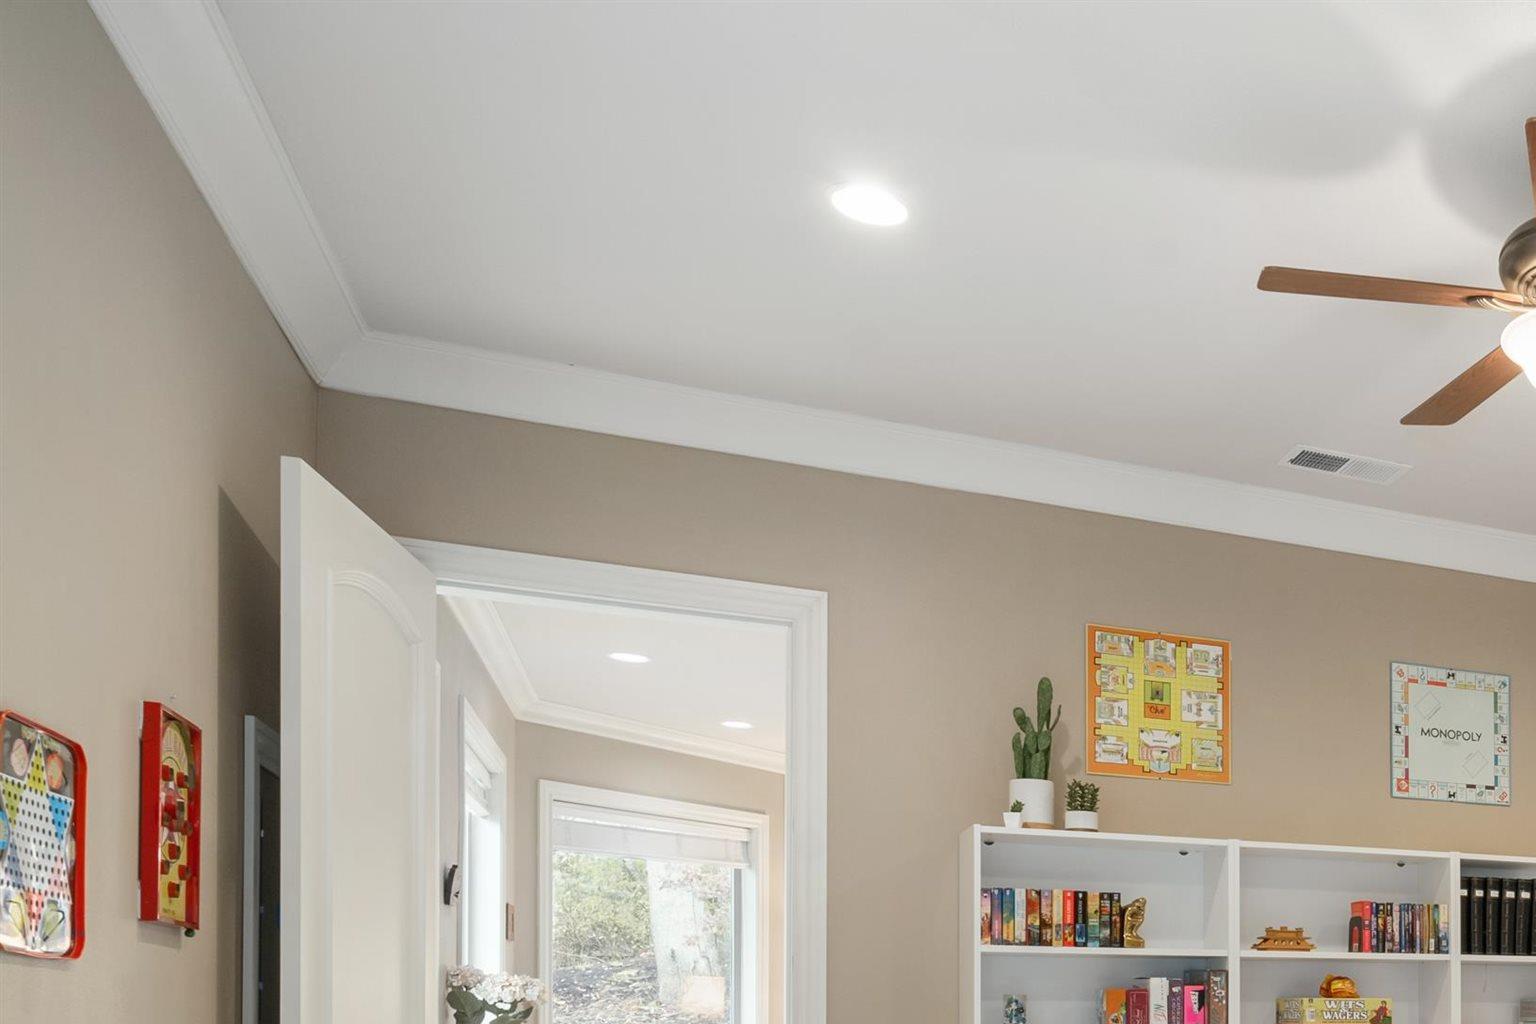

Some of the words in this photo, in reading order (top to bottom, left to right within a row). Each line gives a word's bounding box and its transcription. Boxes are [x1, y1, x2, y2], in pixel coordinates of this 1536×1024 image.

[1420, 727, 1482, 742] MONOPOLY
[1324, 999, 1365, 1009] WITS
[1323, 1010, 1367, 1020] WAGERS
